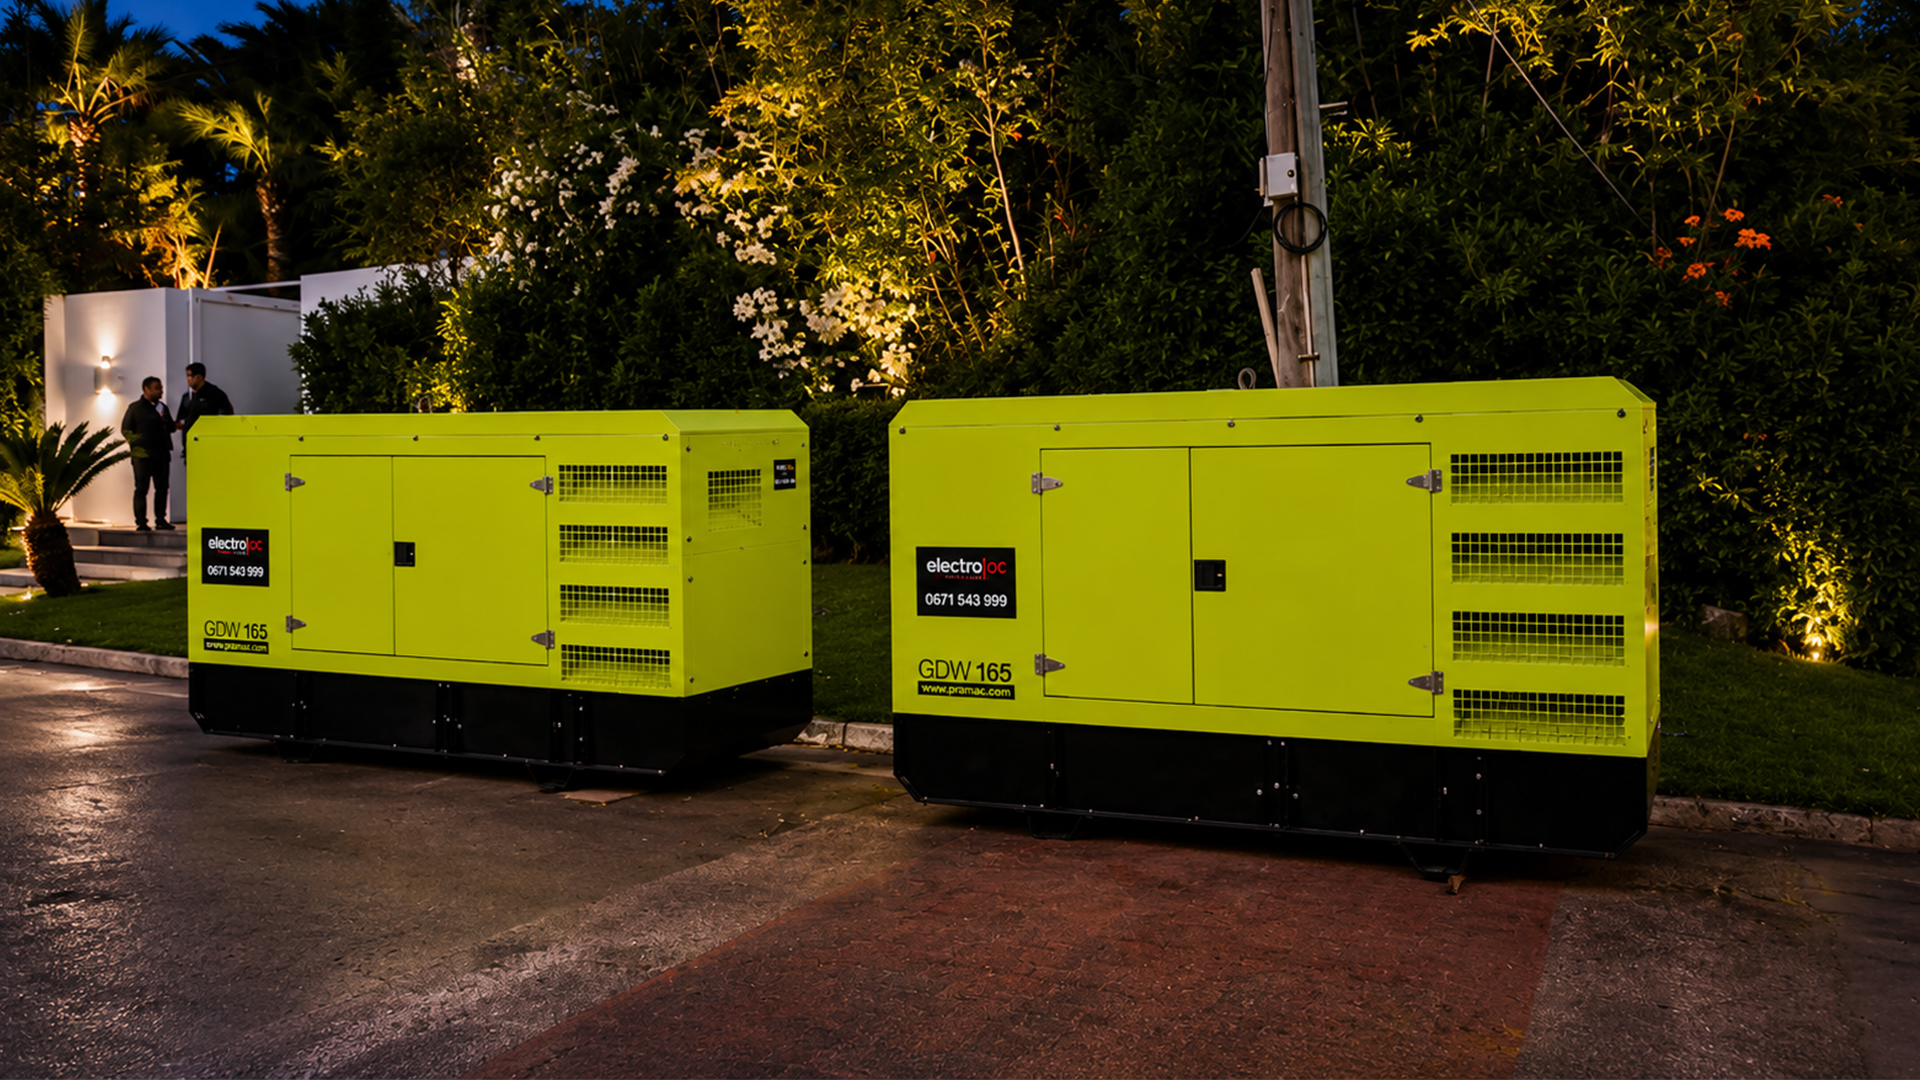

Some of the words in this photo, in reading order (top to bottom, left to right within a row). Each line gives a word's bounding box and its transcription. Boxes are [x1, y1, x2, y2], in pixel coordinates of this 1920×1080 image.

[207, 565, 228, 576] 0671
[229, 565, 246, 577] 543
[247, 566, 264, 578] 999
[925, 592, 954, 606] 0671
[957, 593, 981, 607] 543
[983, 594, 1008, 608] 999
[204, 620, 241, 638] GDW
[243, 623, 268, 640] 165
[918, 658, 972, 681] GDW
[976, 662, 1012, 682] 165
[921, 684, 1011, 697] www.pramac.com
